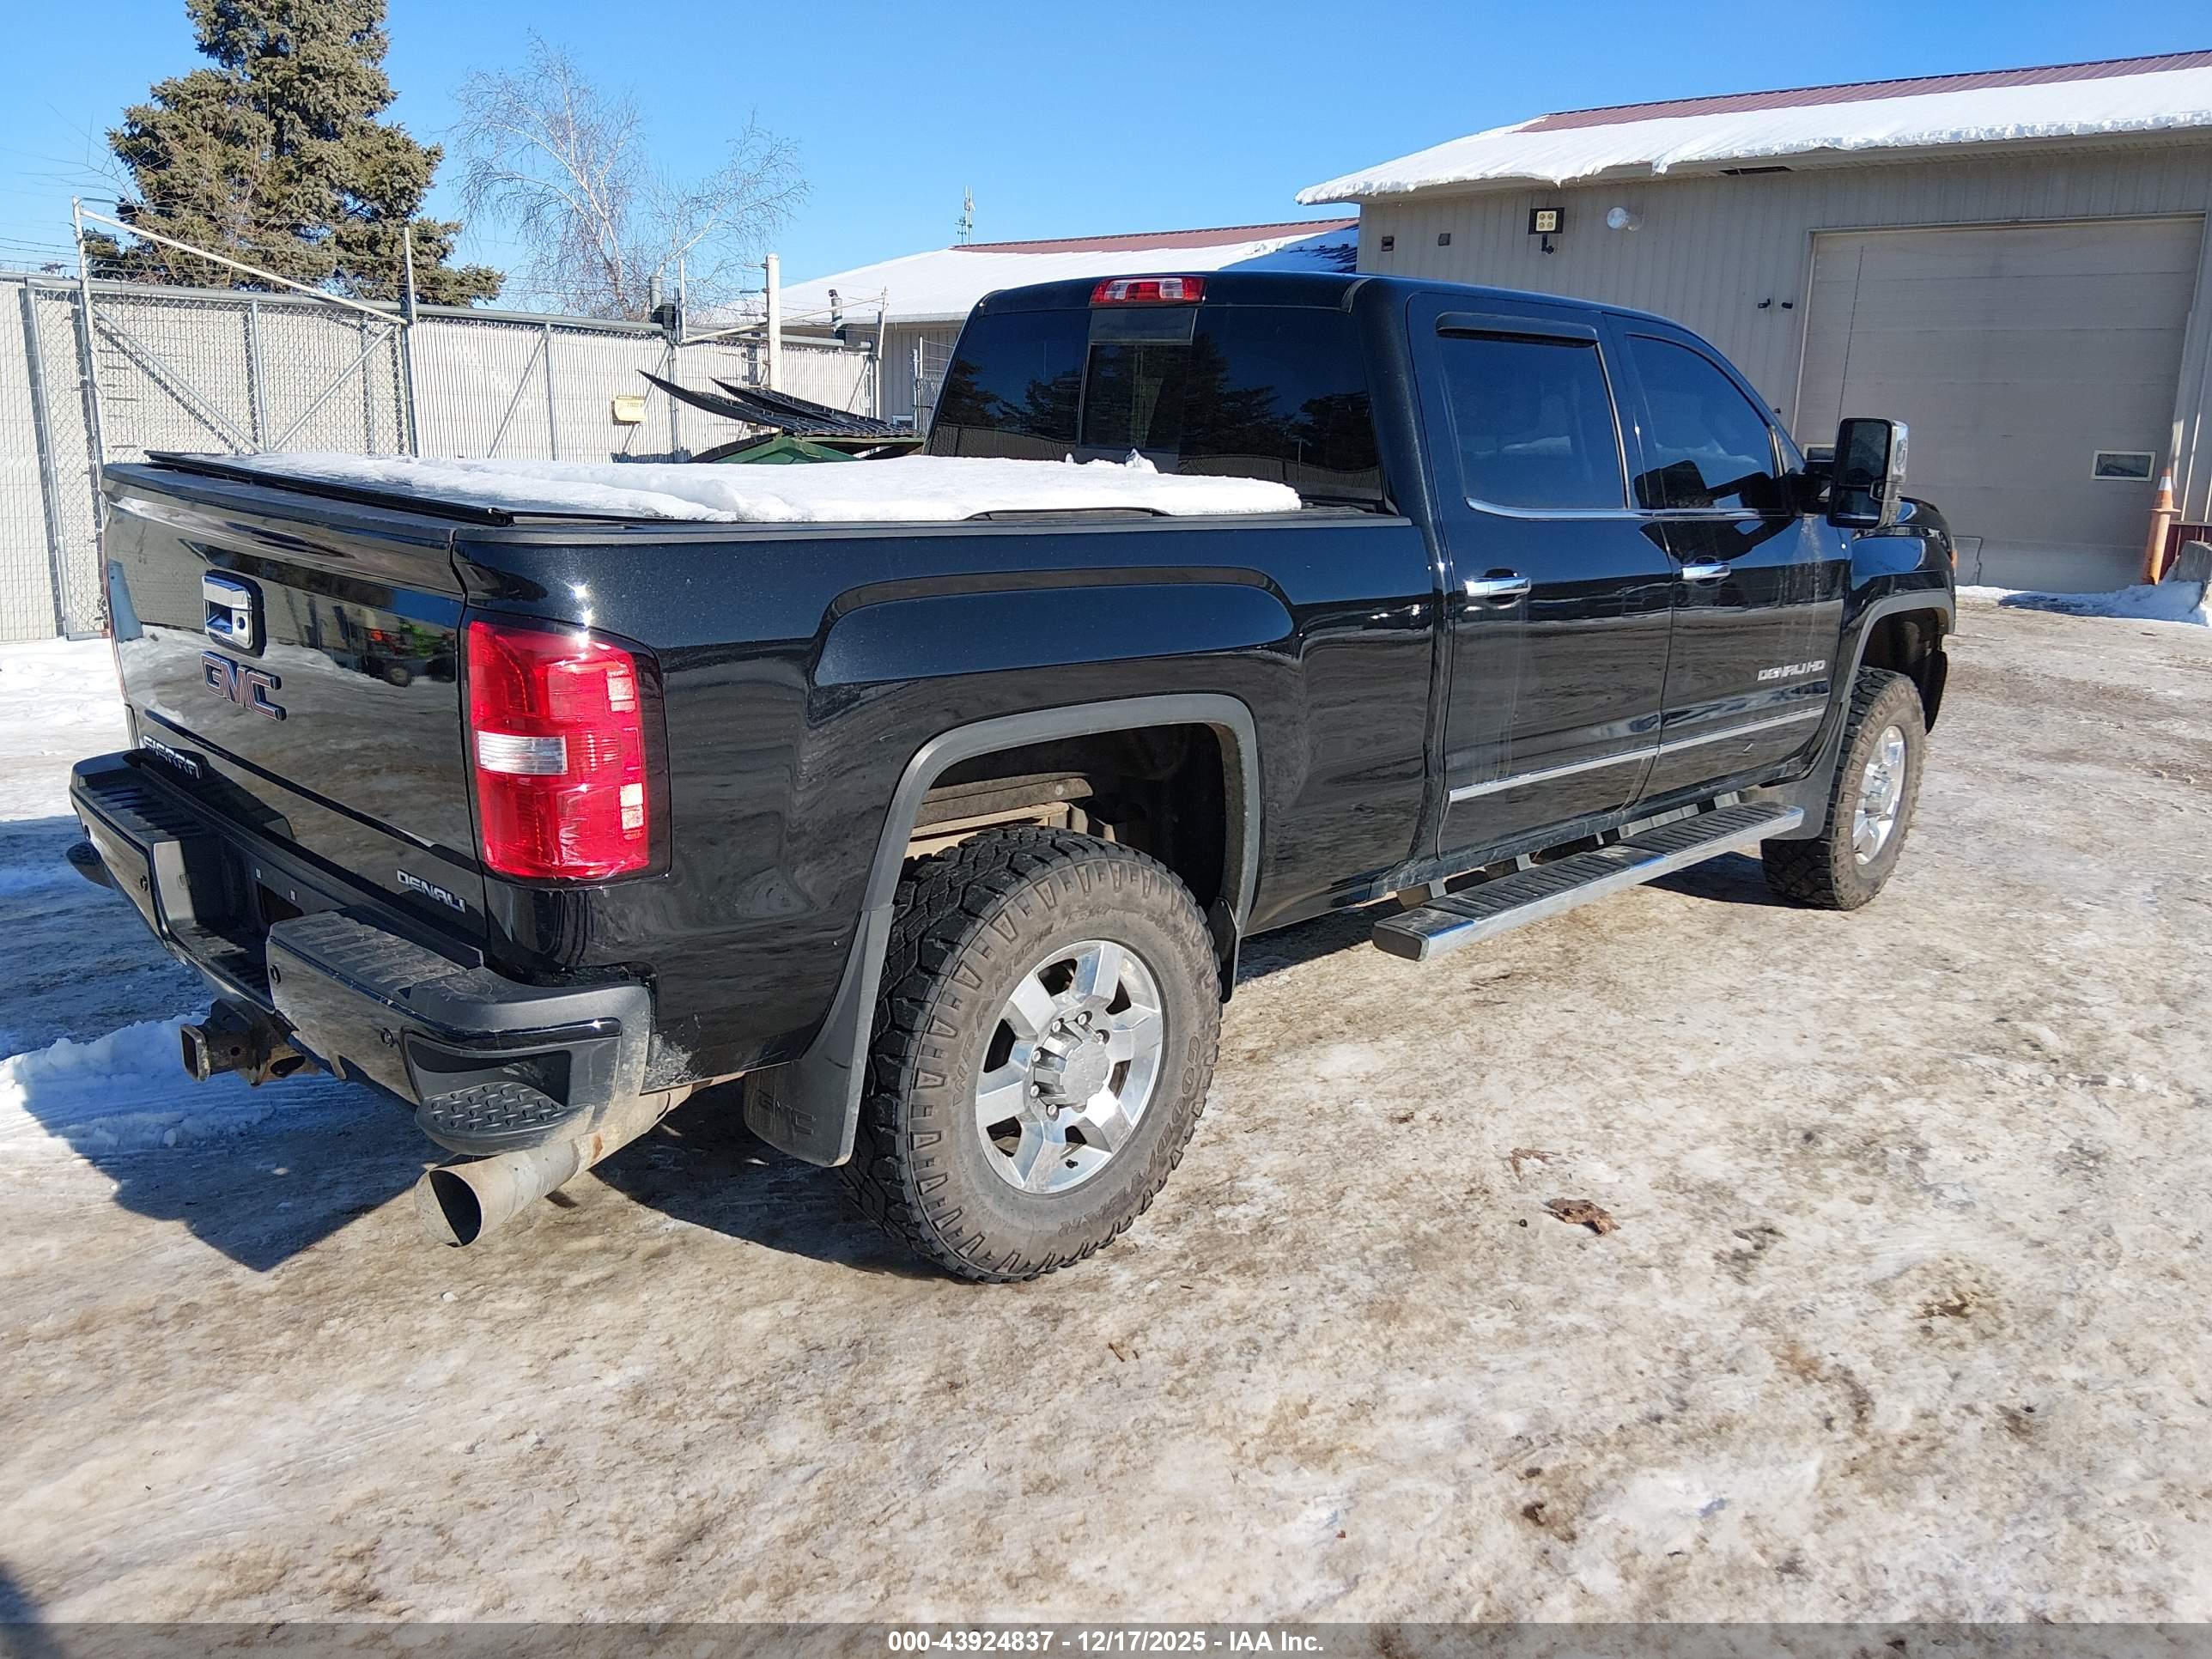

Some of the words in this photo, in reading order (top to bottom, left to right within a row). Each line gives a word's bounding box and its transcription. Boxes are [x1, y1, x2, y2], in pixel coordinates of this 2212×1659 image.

[200, 651, 286, 720] GMC
[143, 735, 201, 780] SIERRA
[397, 869, 466, 914] DENALI
